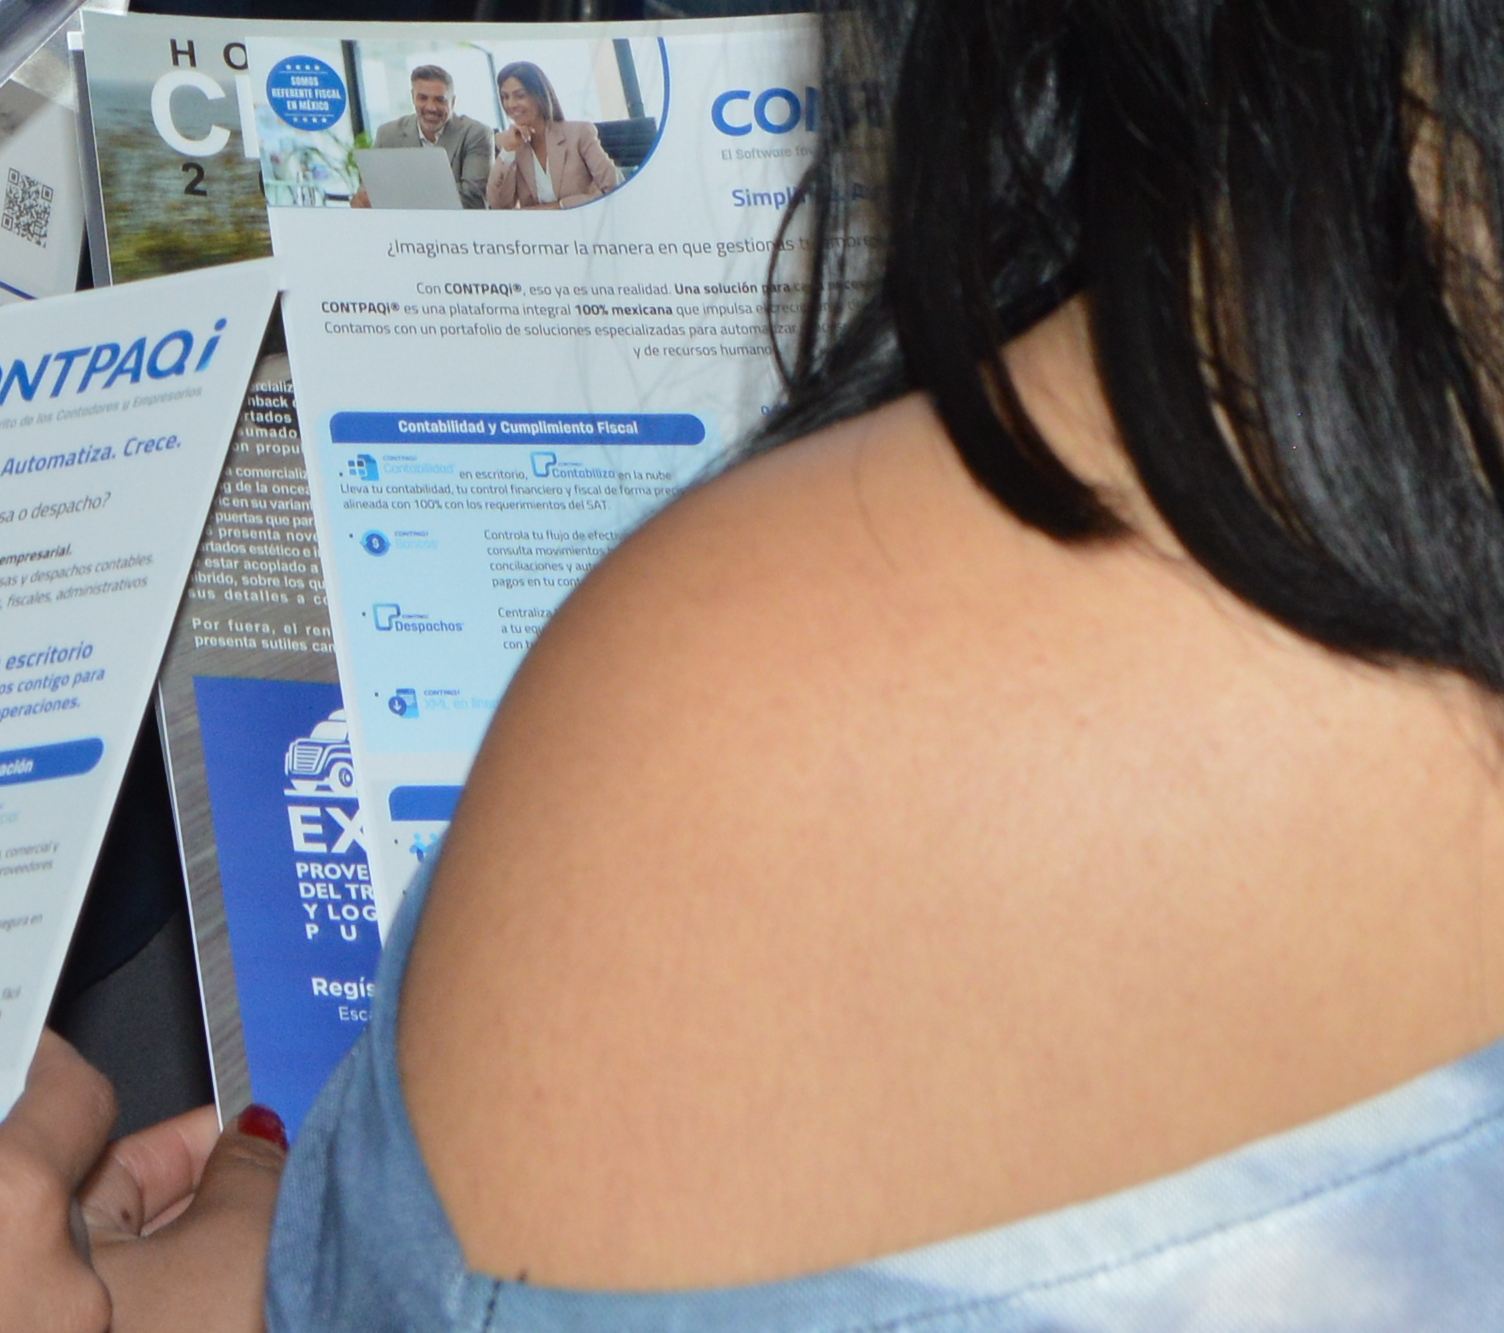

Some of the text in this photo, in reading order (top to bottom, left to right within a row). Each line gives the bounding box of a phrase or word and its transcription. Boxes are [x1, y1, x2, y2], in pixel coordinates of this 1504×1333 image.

[291, 76, 319, 86] SOMOS
[271, 88, 341, 99] REFERENTE FISCAL
[287, 99, 329, 110] EN MÉXICO
[721, 147, 791, 160] El Software
[387, 240, 468, 258] ¿Imaginas
[473, 240, 569, 255] transformar
[574, 240, 588, 255] la
[592, 242, 654, 255] manera
[658, 243, 678, 255] en
[682, 241, 711, 257] que
[416, 283, 441, 295] Con
[529, 285, 551, 295] eso
[554, 284, 570, 298] ya
[573, 285, 588, 295] es
[592, 285, 614, 295] una
[618, 283, 672, 295] realidad.
[675, 283, 700, 295] Una
[704, 282, 758, 294] solución
[403, 304, 418, 315] es
[422, 304, 445, 315] una
[449, 303, 519, 317] plataforma
[523, 304, 571, 318] integral
[576, 304, 608, 316] 100%
[612, 305, 673, 315] mexicana
[676, 305, 700, 317] que
[703, 303, 752, 317] impulsa
[398, 419, 639, 436] Contabilidad y Cumplimiento Fiscal
[0, 443, 116, 478] Automatiza.
[123, 435, 181, 457] Crece.
[215, 511, 289, 529] puertas que
[218, 527, 281, 541] presenta
[249, 544, 300, 557] estético
[205, 557, 306, 574] estar acoplado
[242, 575, 304, 589] sobre los
[224, 589, 288, 603] detalles
[193, 617, 297, 635] Por fuera, el
[395, 620, 463, 633] Despachos
[195, 636, 307, 652] presenta sutiles
[6, 641, 93, 671] escritorio
[17, 673, 69, 693] contigo
[72, 668, 105, 689] para
[299, 882, 342, 900] DEL
[303, 903, 318, 920] Y
